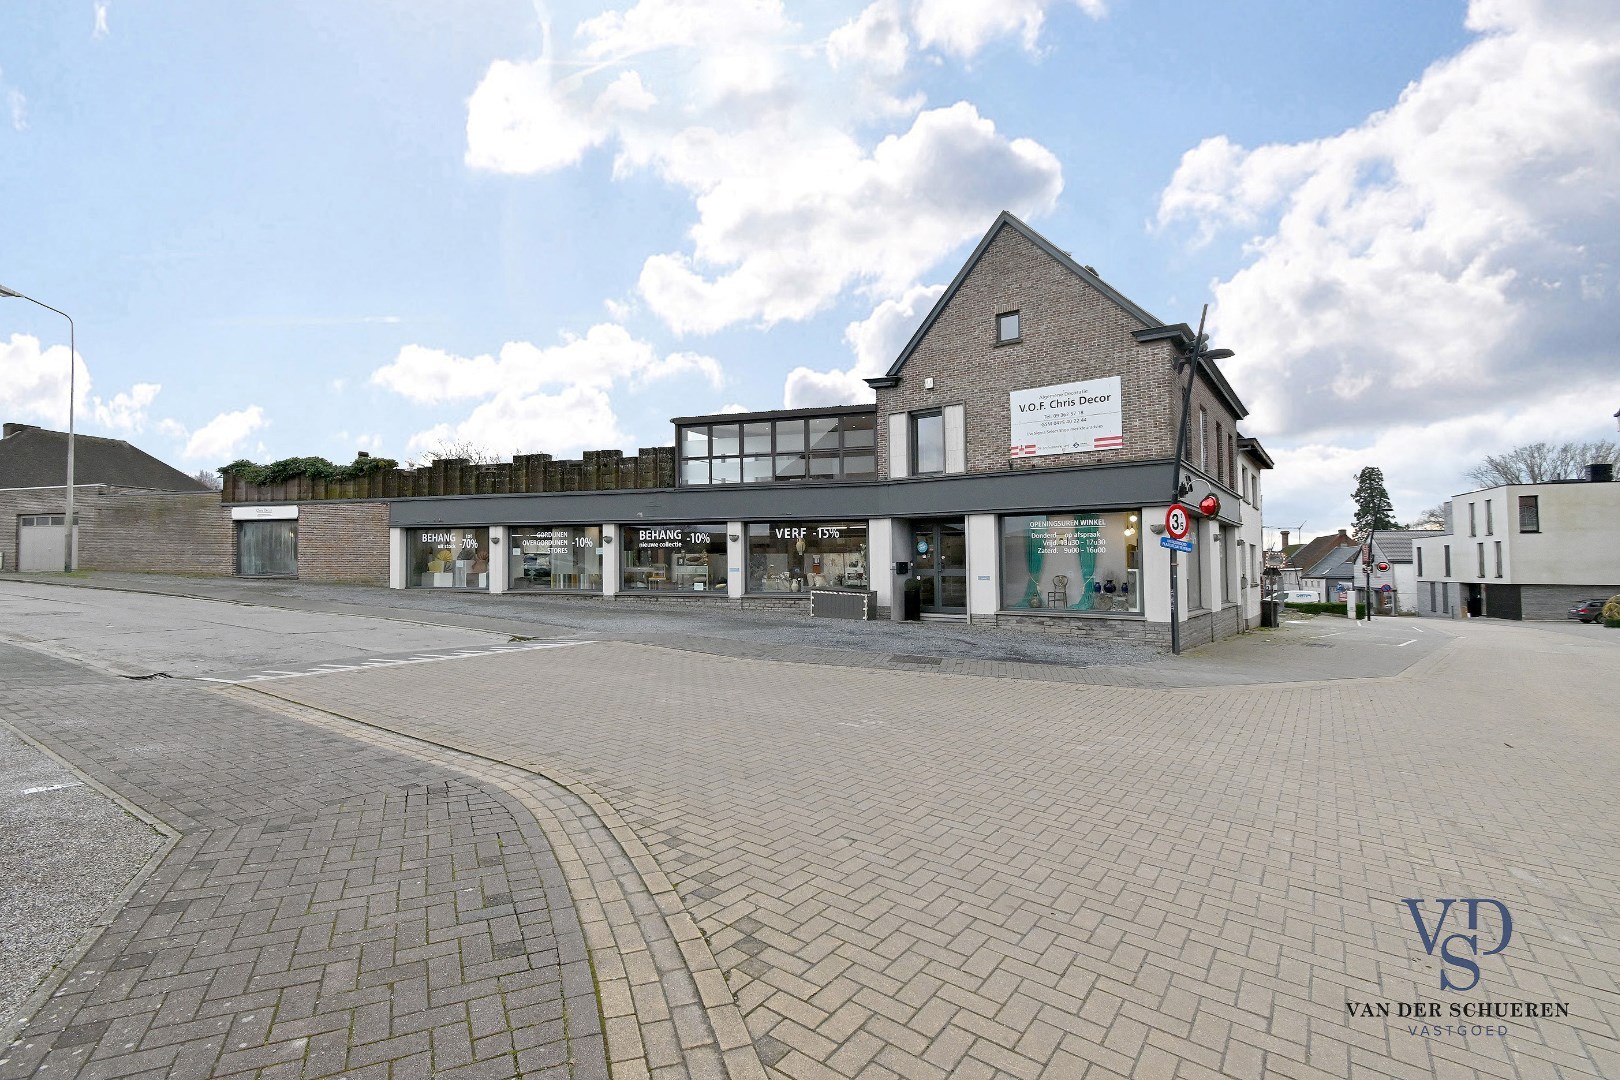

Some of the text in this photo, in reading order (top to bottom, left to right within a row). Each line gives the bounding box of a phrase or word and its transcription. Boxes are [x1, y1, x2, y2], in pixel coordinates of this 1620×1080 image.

[1019, 394, 1112, 413] V.O.F. Chris Decor
[1030, 518, 1107, 528] OPENINGSUREN WINKEL
[422, 533, 456, 542] BEHANG
[639, 529, 711, 544] BEHANG -10%
[775, 527, 840, 539] VERF -15%
[1073, 531, 1101, 540] afspraak
[459, 538, 479, 549] -70%
[572, 537, 594, 548] -10%
[1086, 546, 1106, 554] 16u00
